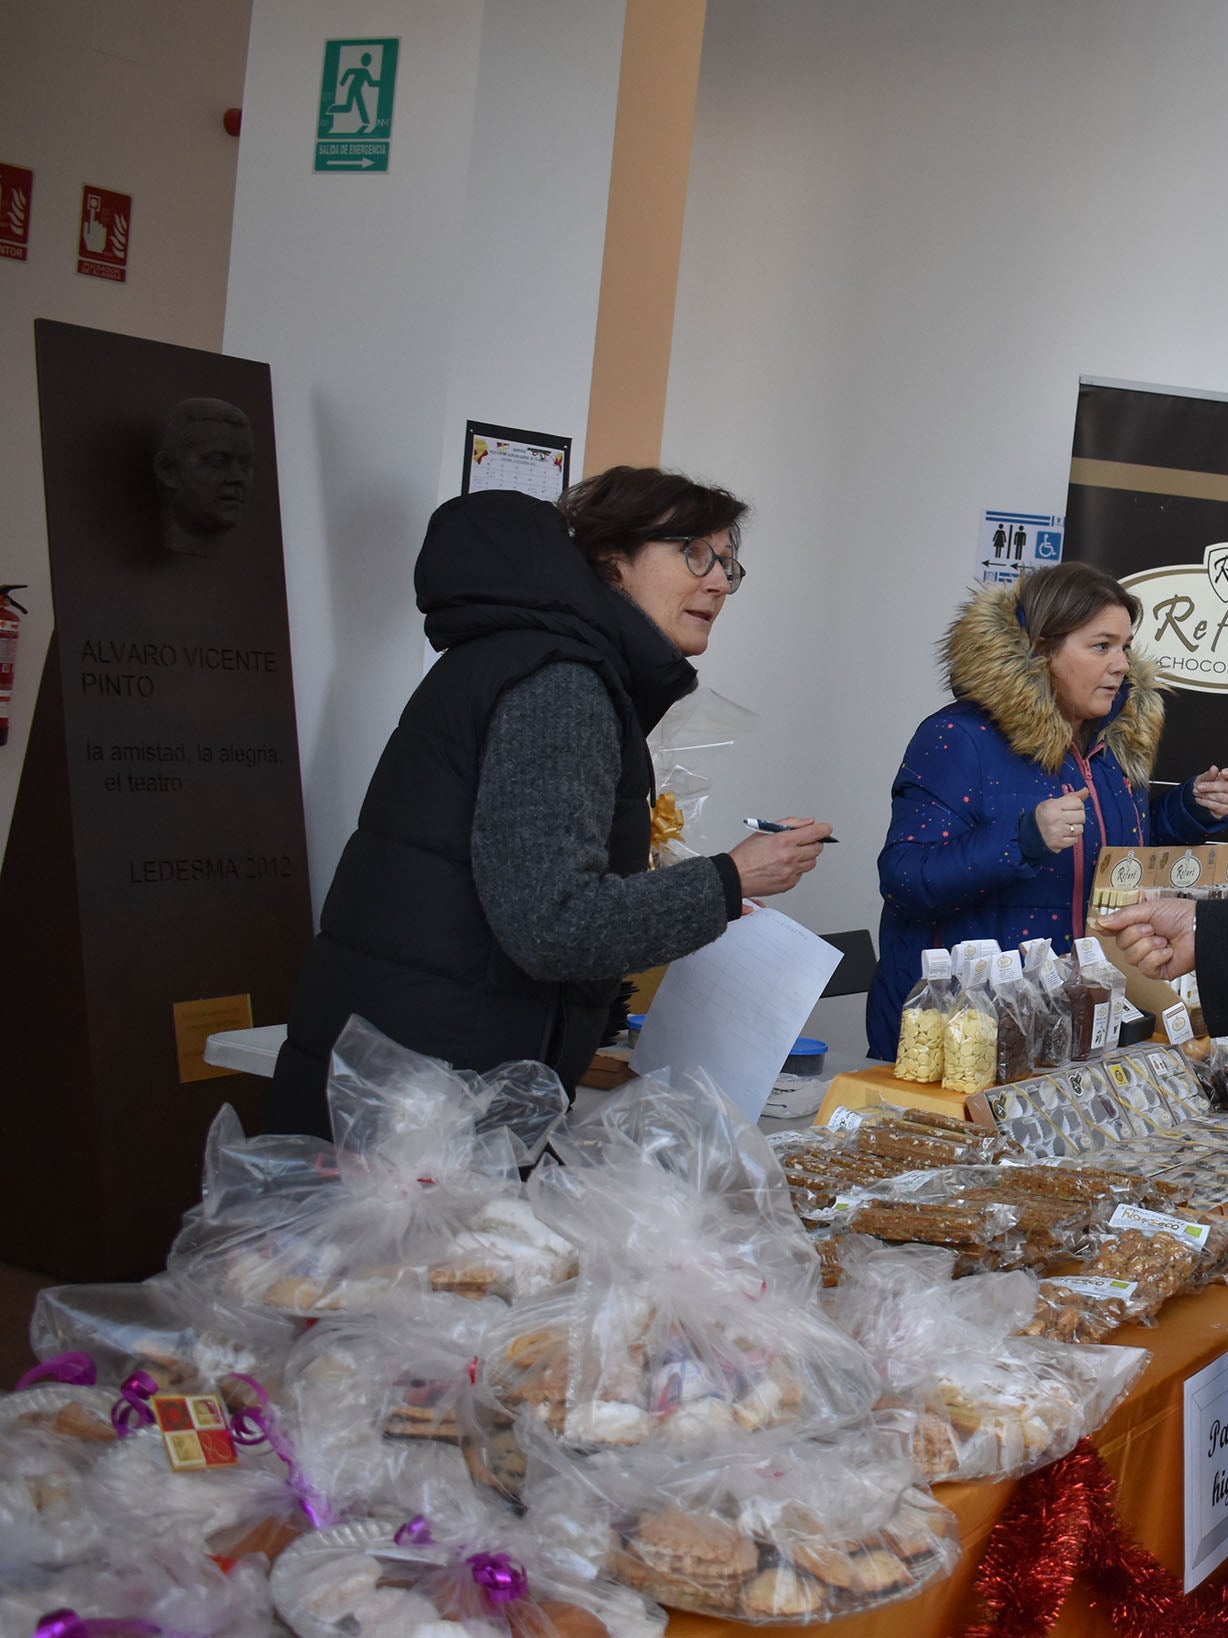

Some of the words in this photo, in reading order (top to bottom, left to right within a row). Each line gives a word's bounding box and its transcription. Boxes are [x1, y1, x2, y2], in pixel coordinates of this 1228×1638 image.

[81, 640, 177, 666] ALVARO
[184, 647, 280, 673] VICENTE
[81, 672, 155, 697] PINTO
[86, 740, 105, 761] la
[197, 744, 214, 763] la
[104, 773, 121, 792] el
[128, 774, 183, 793] teatro
[128, 857, 240, 883] LEDESMA
